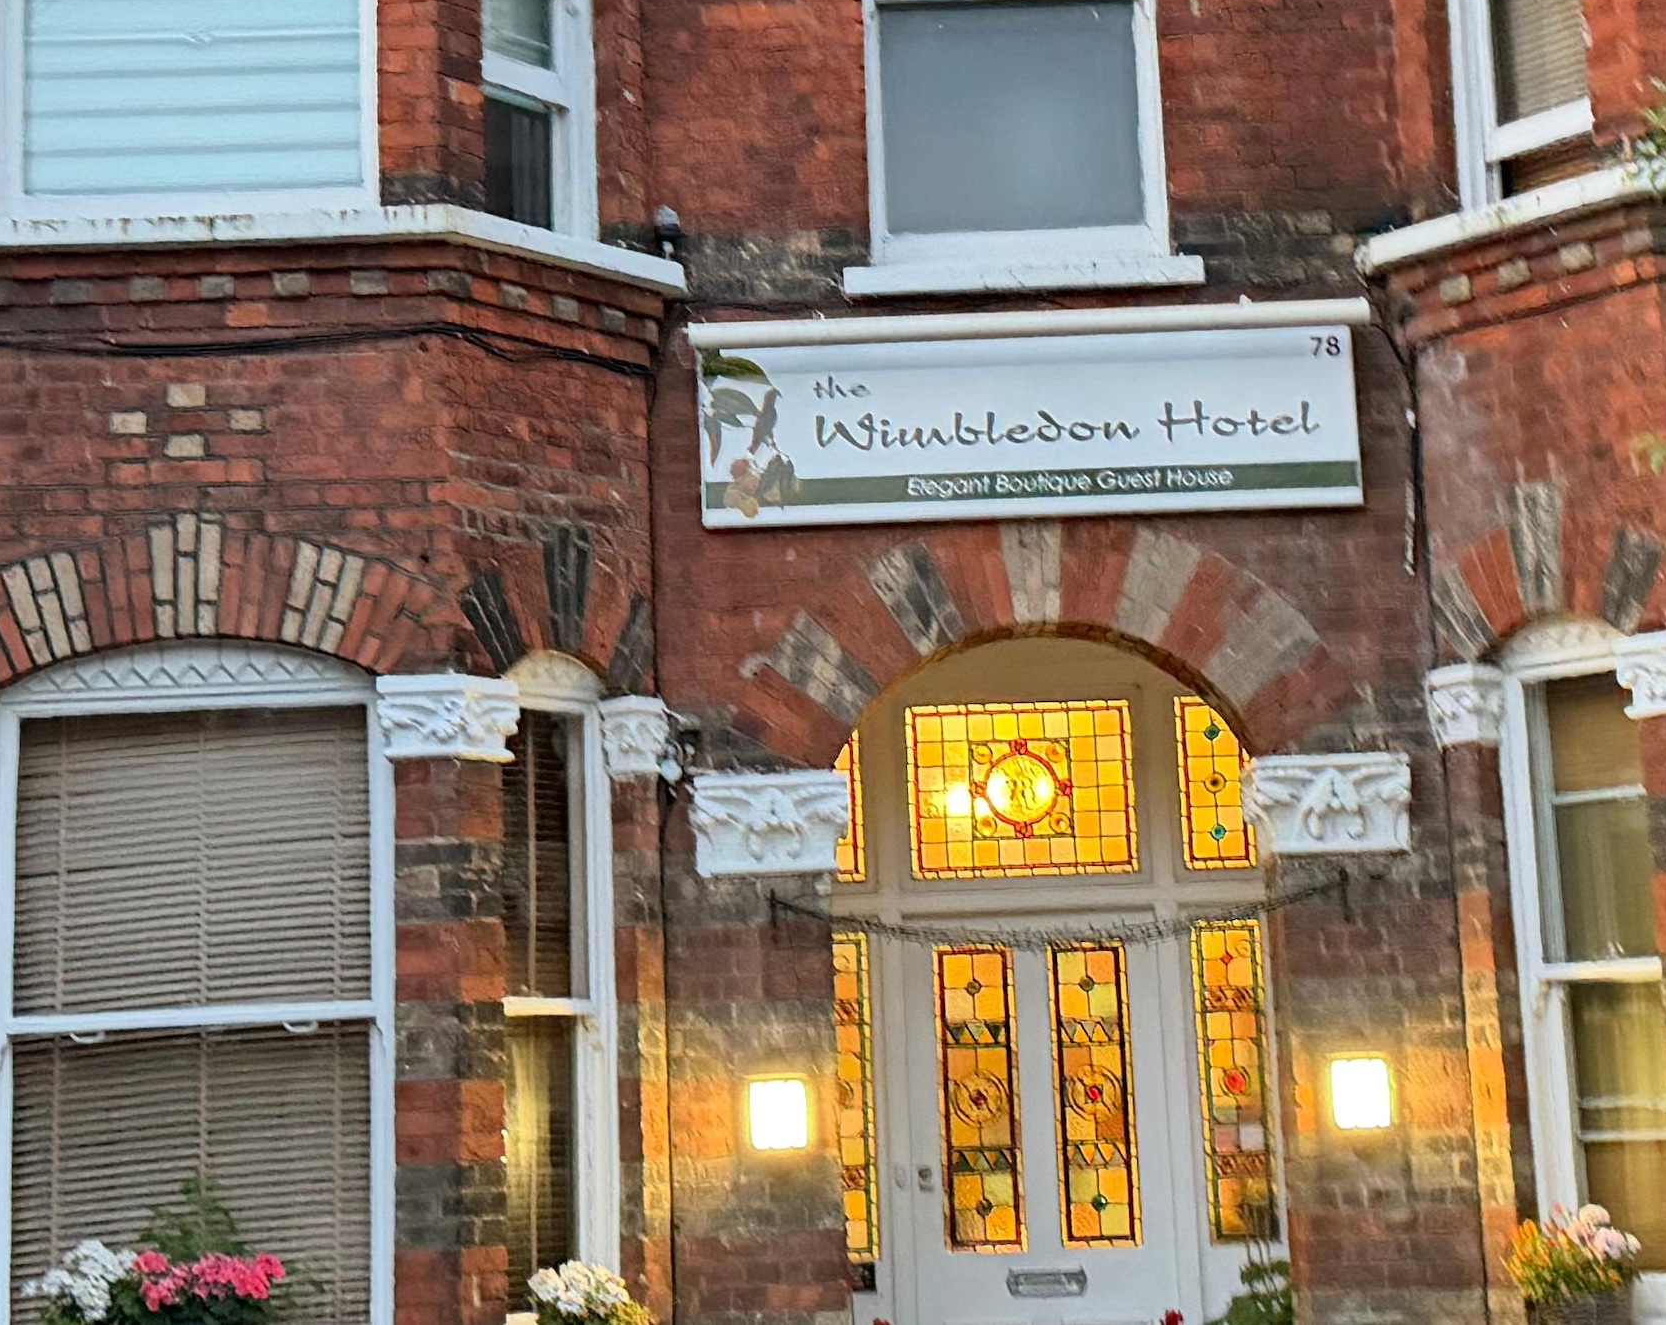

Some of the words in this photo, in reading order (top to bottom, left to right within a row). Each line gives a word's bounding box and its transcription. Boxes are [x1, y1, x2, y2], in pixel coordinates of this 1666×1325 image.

[1309, 335, 1342, 358] 78
[812, 375, 869, 400] the
[815, 410, 1141, 451] Wimbledon
[1157, 400, 1321, 443] Hotel
[906, 475, 991, 498] Elegant
[994, 471, 1093, 495] Boutique
[1097, 469, 1162, 490] Guest
[1166, 467, 1234, 487] House
